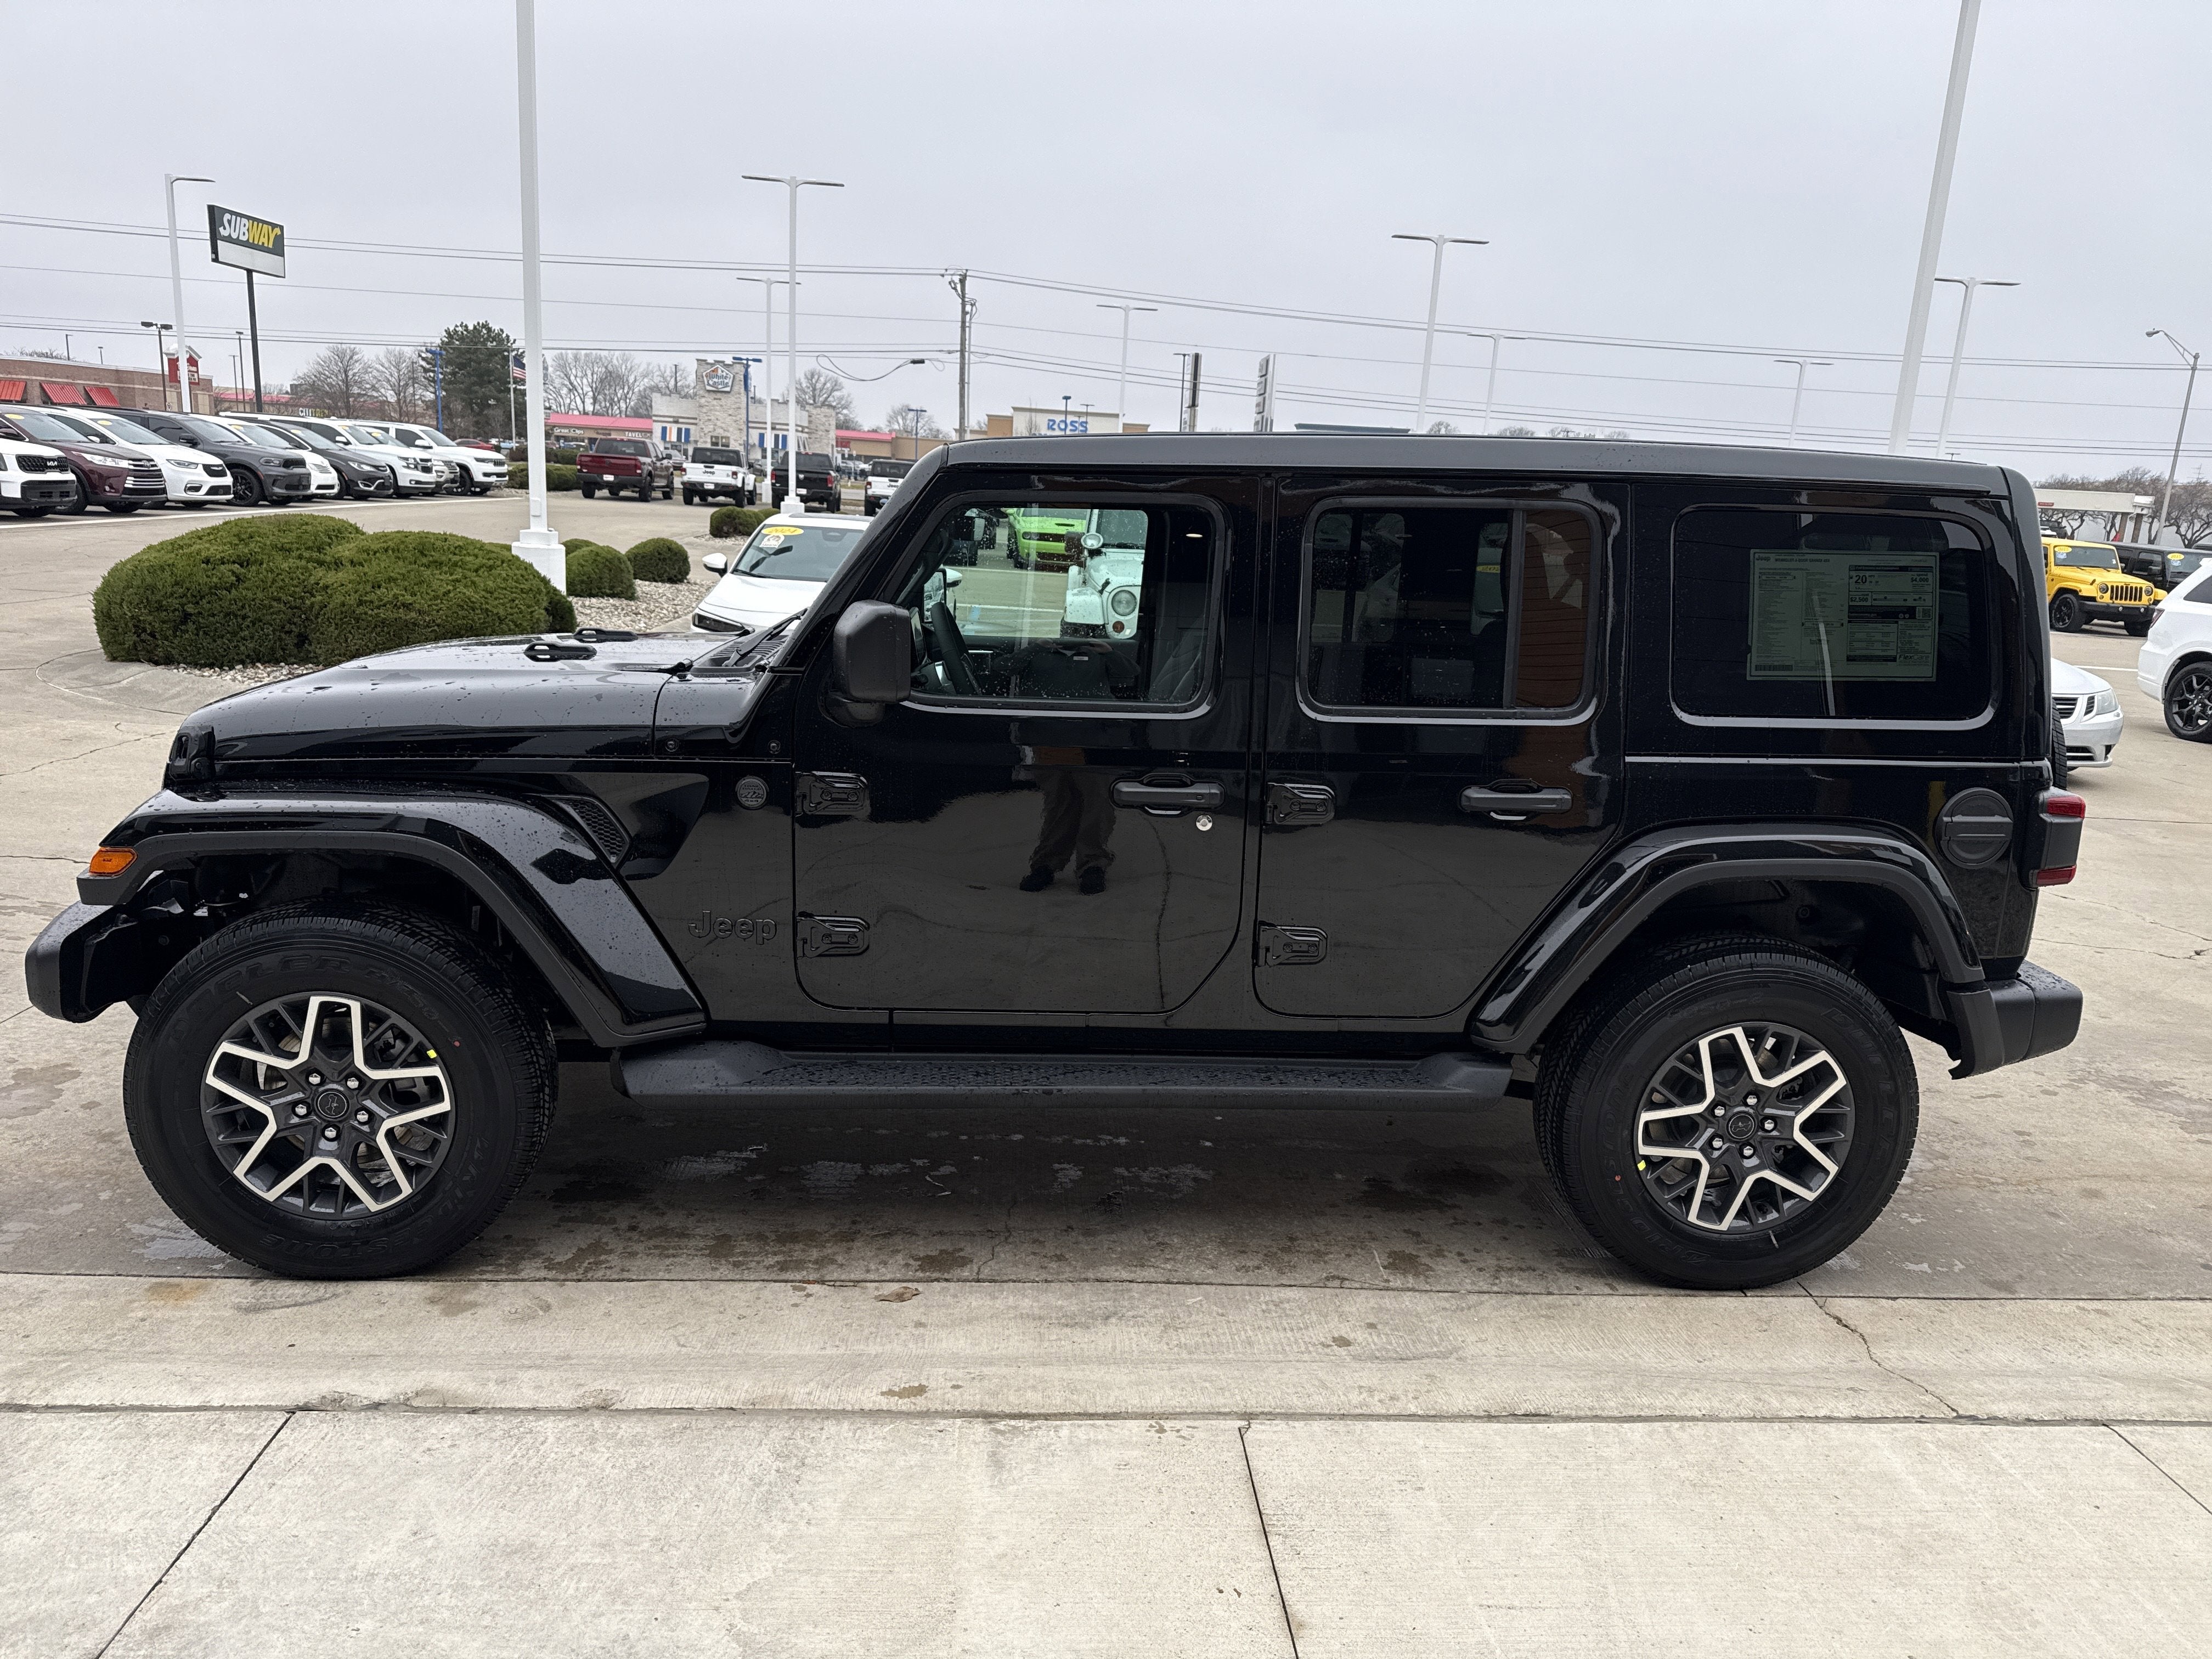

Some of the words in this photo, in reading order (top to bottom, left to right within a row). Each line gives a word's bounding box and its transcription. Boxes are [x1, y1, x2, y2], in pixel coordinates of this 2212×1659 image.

[219, 213, 281, 249] SUBWAY
[1047, 419, 1088, 432] ROSS
[1855, 575, 1867, 584] 20
[689, 910, 777, 945] Jeep
